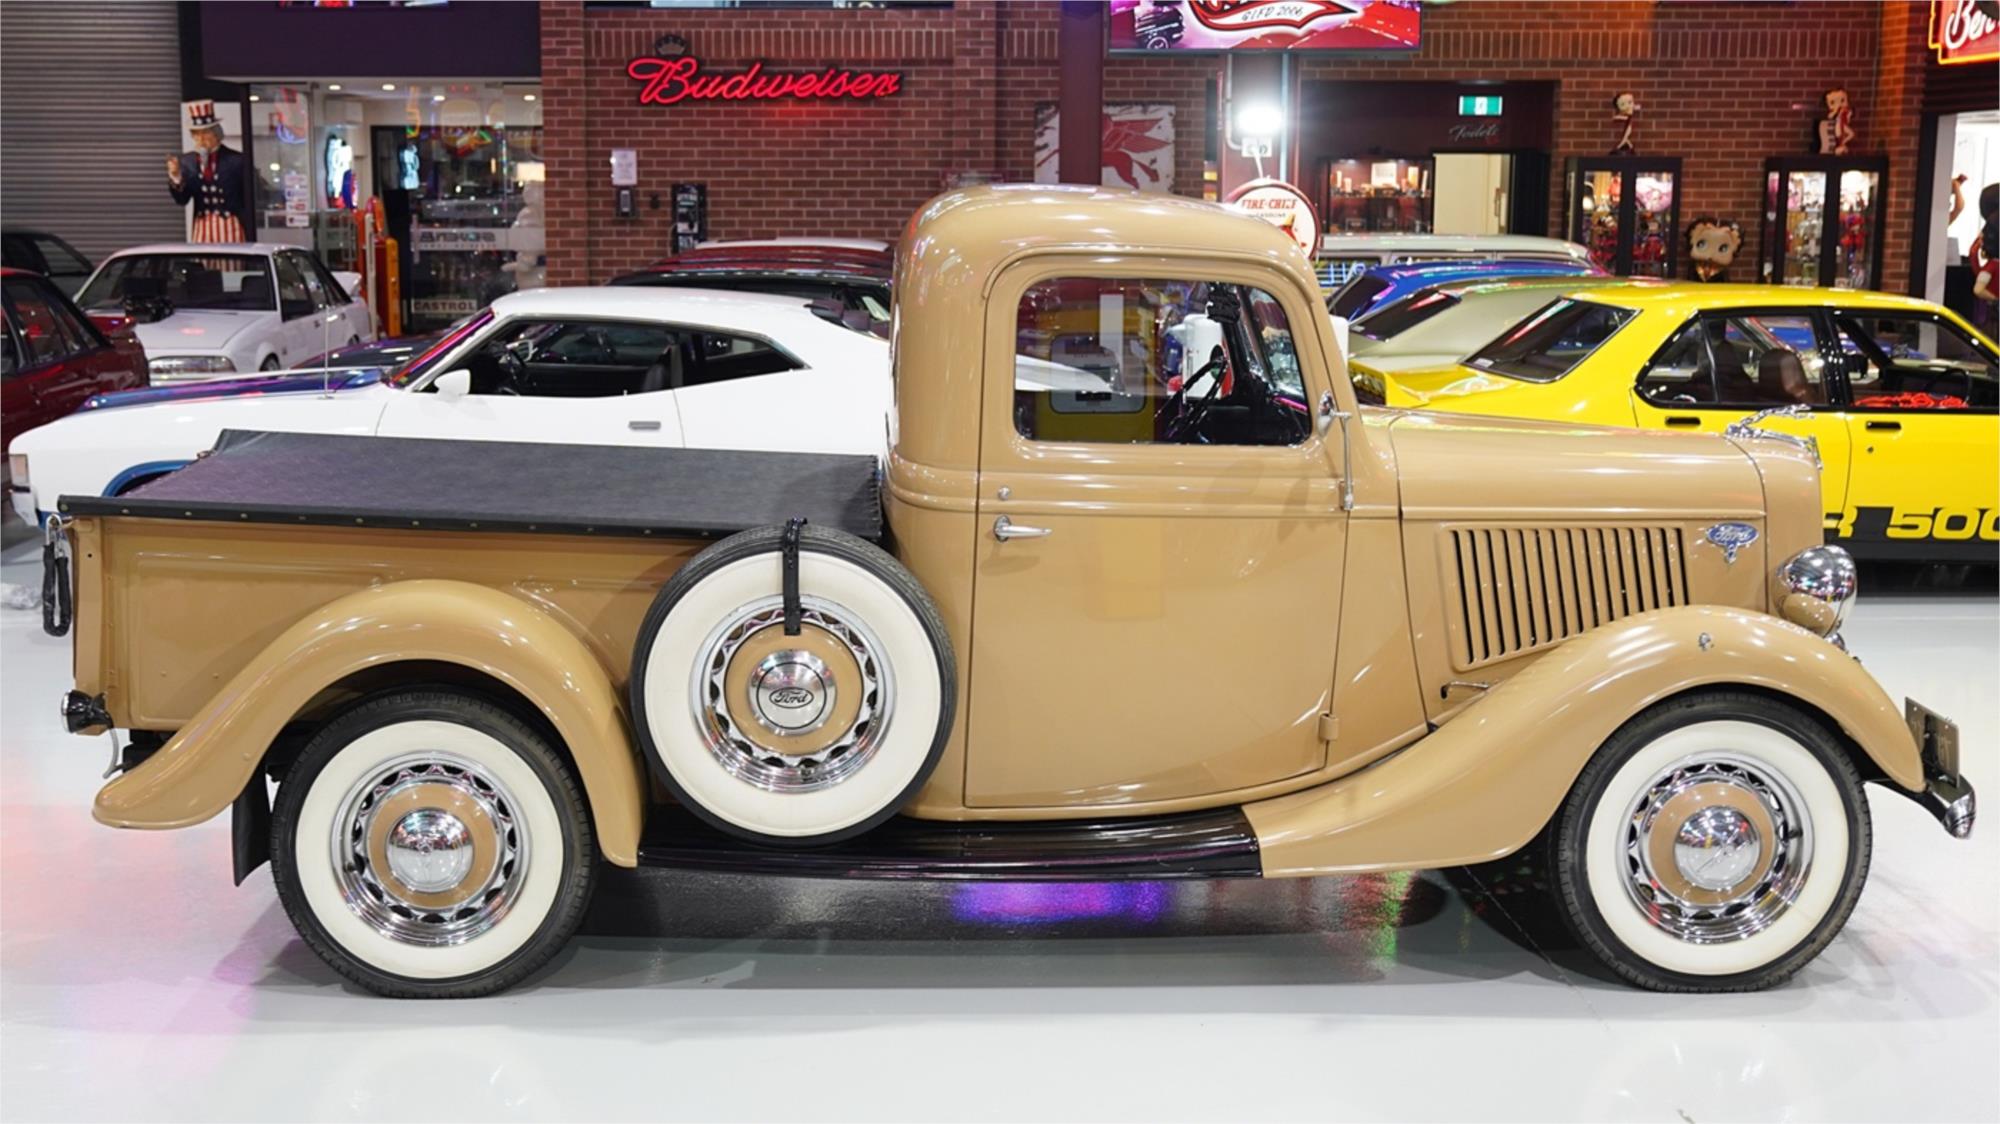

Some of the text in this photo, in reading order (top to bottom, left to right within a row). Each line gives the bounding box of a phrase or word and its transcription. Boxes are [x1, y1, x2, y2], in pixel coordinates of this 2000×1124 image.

[628, 57, 899, 104] Budweiser
[413, 301, 475, 312] CASTROL
[1713, 525, 1754, 541] Ford
[774, 691, 808, 704] Ford
